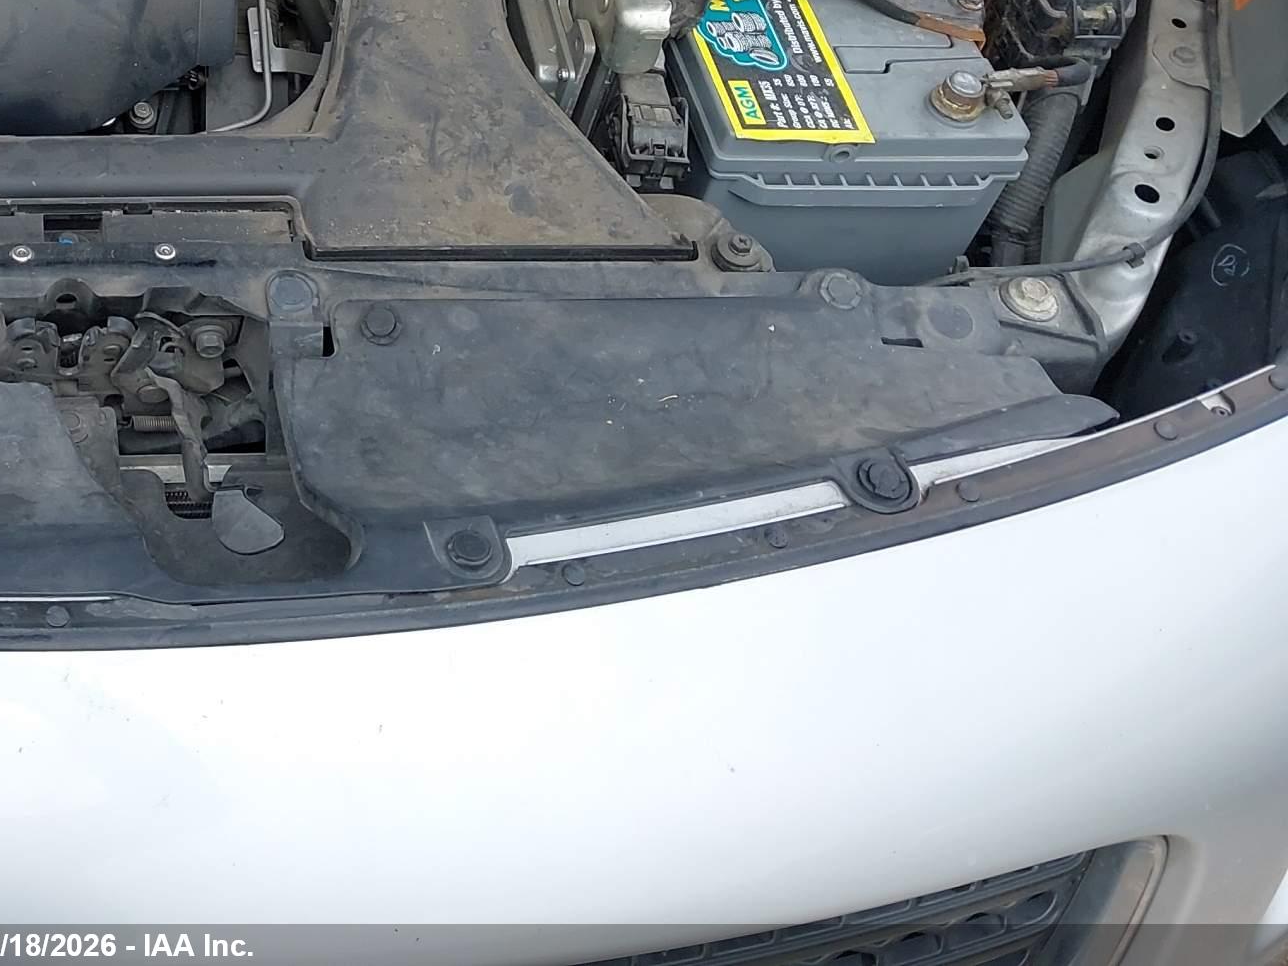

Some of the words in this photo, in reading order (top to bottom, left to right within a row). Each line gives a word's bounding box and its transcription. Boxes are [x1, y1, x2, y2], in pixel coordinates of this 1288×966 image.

[774, 9, 804, 54] Distributed
[790, 3, 823, 64] www.mavis.com
[758, 80, 777, 101] MX35
[772, 78, 783, 87] 35
[734, 87, 761, 120] AGM
[773, 111, 789, 129] Part
[788, 109, 801, 129] Group
[803, 115, 816, 129] CCA
[817, 119, 828, 129] CA
